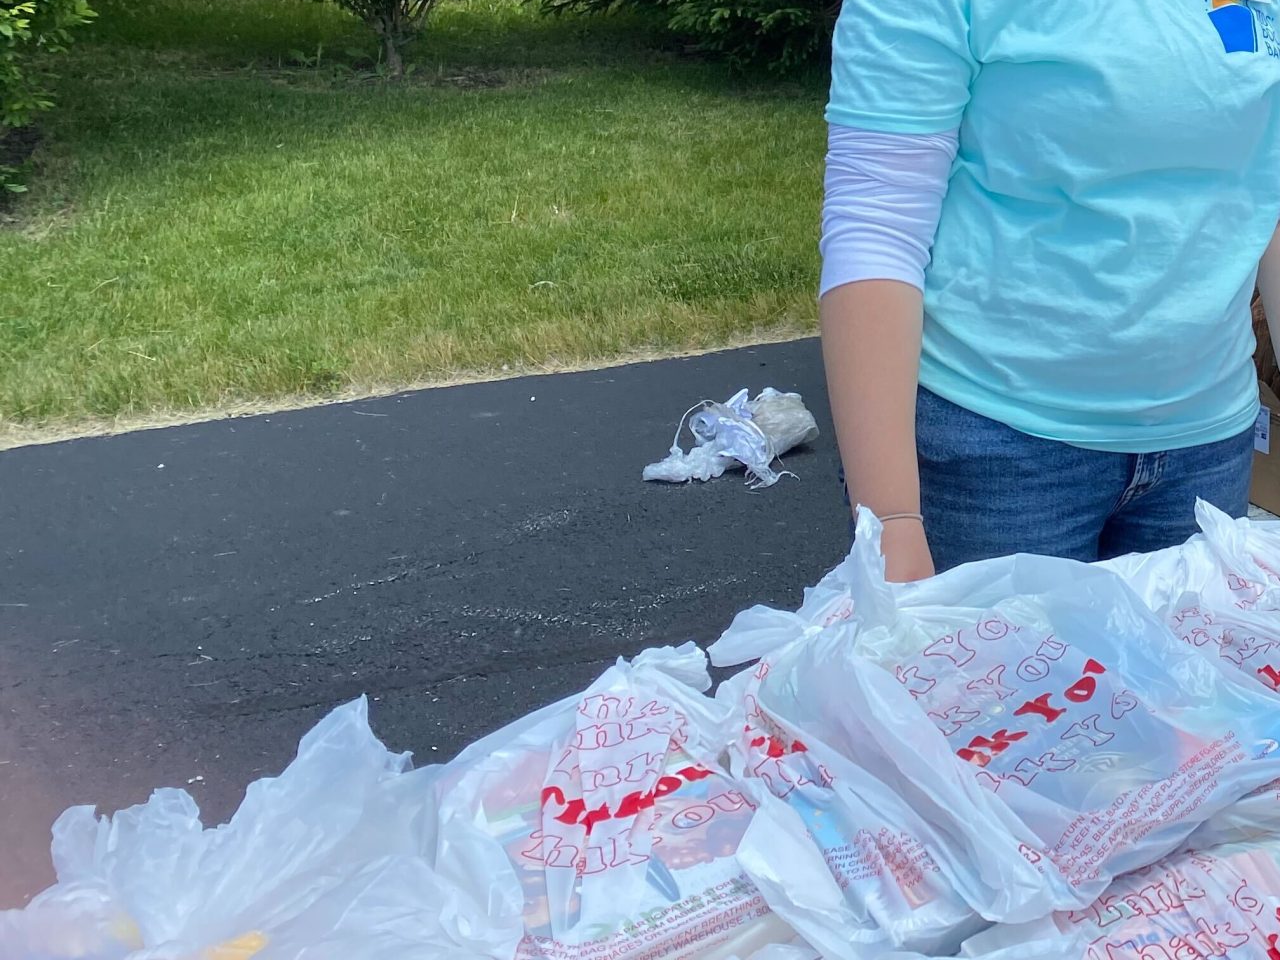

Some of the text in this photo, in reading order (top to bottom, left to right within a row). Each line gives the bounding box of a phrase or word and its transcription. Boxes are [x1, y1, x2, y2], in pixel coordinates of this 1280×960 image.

[1178, 754, 1202, 775] STORE
[624, 895, 702, 934] PARTICIPATING
[667, 901, 705, 924] BABIES
[706, 892, 728, 906] AND
[701, 896, 762, 929] BREATHING
[723, 896, 742, 907] THE
[673, 916, 745, 950] WAREHOUSE
